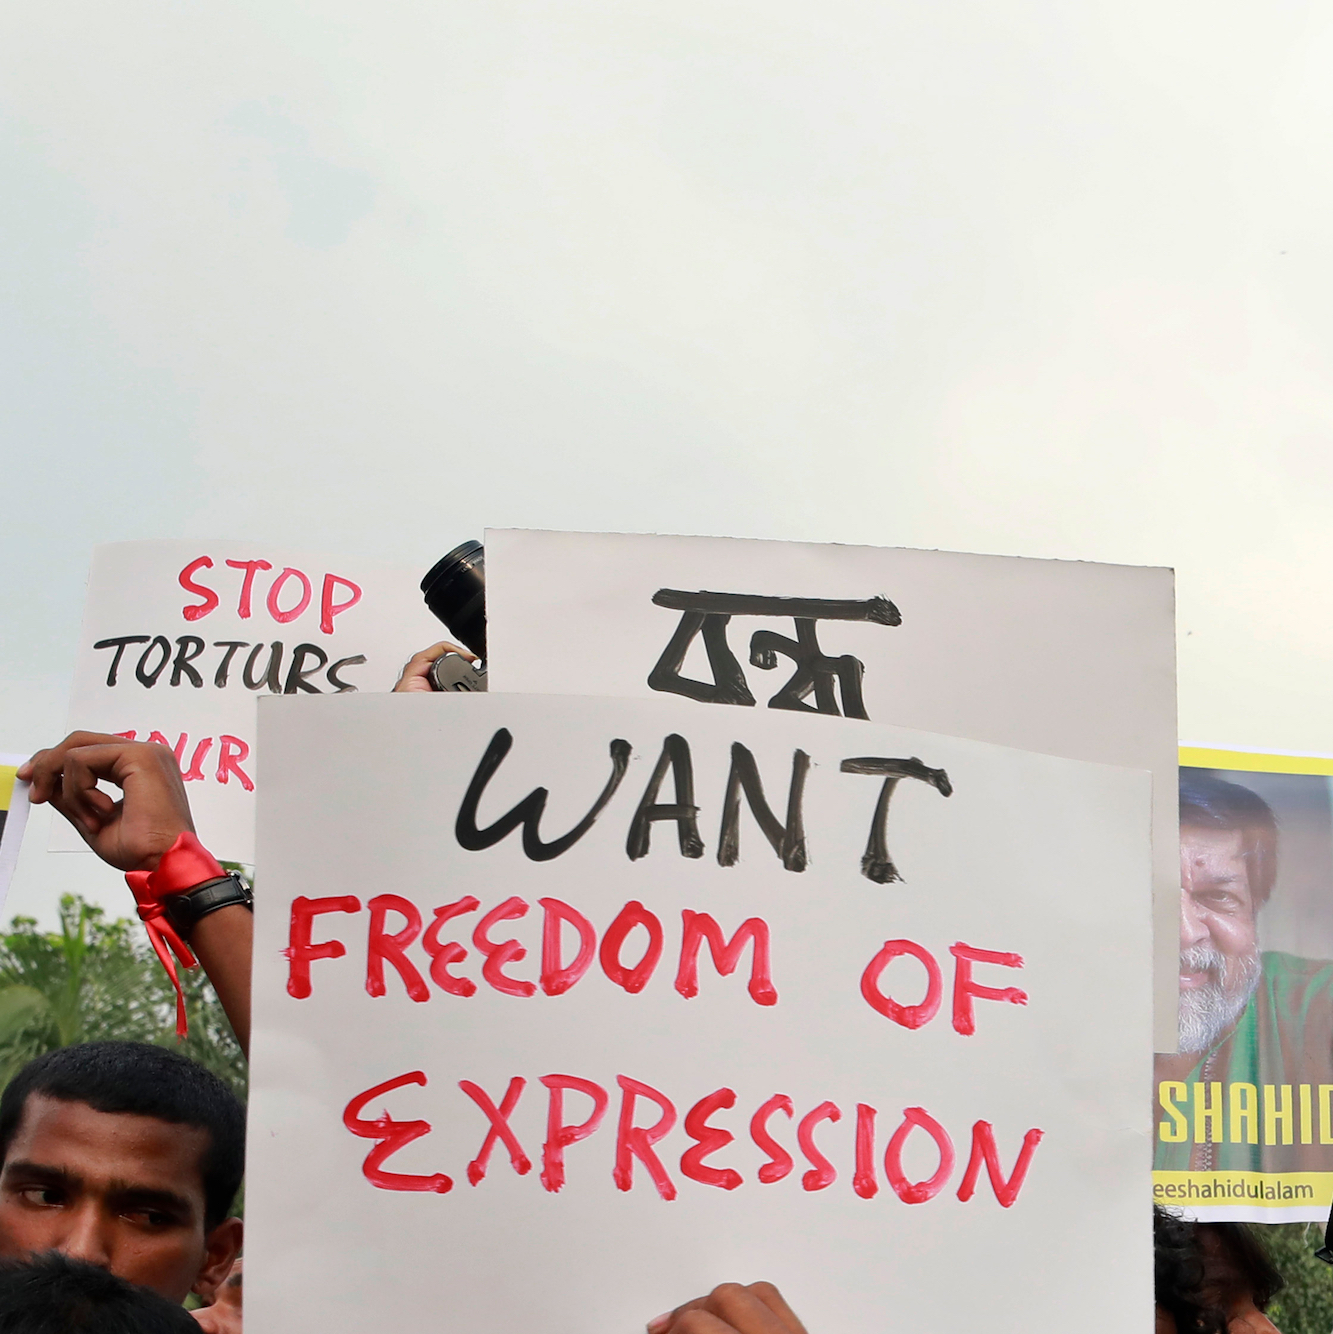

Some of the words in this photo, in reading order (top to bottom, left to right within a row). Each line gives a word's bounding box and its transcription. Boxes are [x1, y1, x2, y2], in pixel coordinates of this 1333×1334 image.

[179, 556, 362, 634] STOP
[455, 727, 953, 884] WANT
[284, 894, 778, 1006] FREEDOM
[861, 938, 1028, 1036] OF
[343, 1070, 1045, 1208] EXPRESSION
